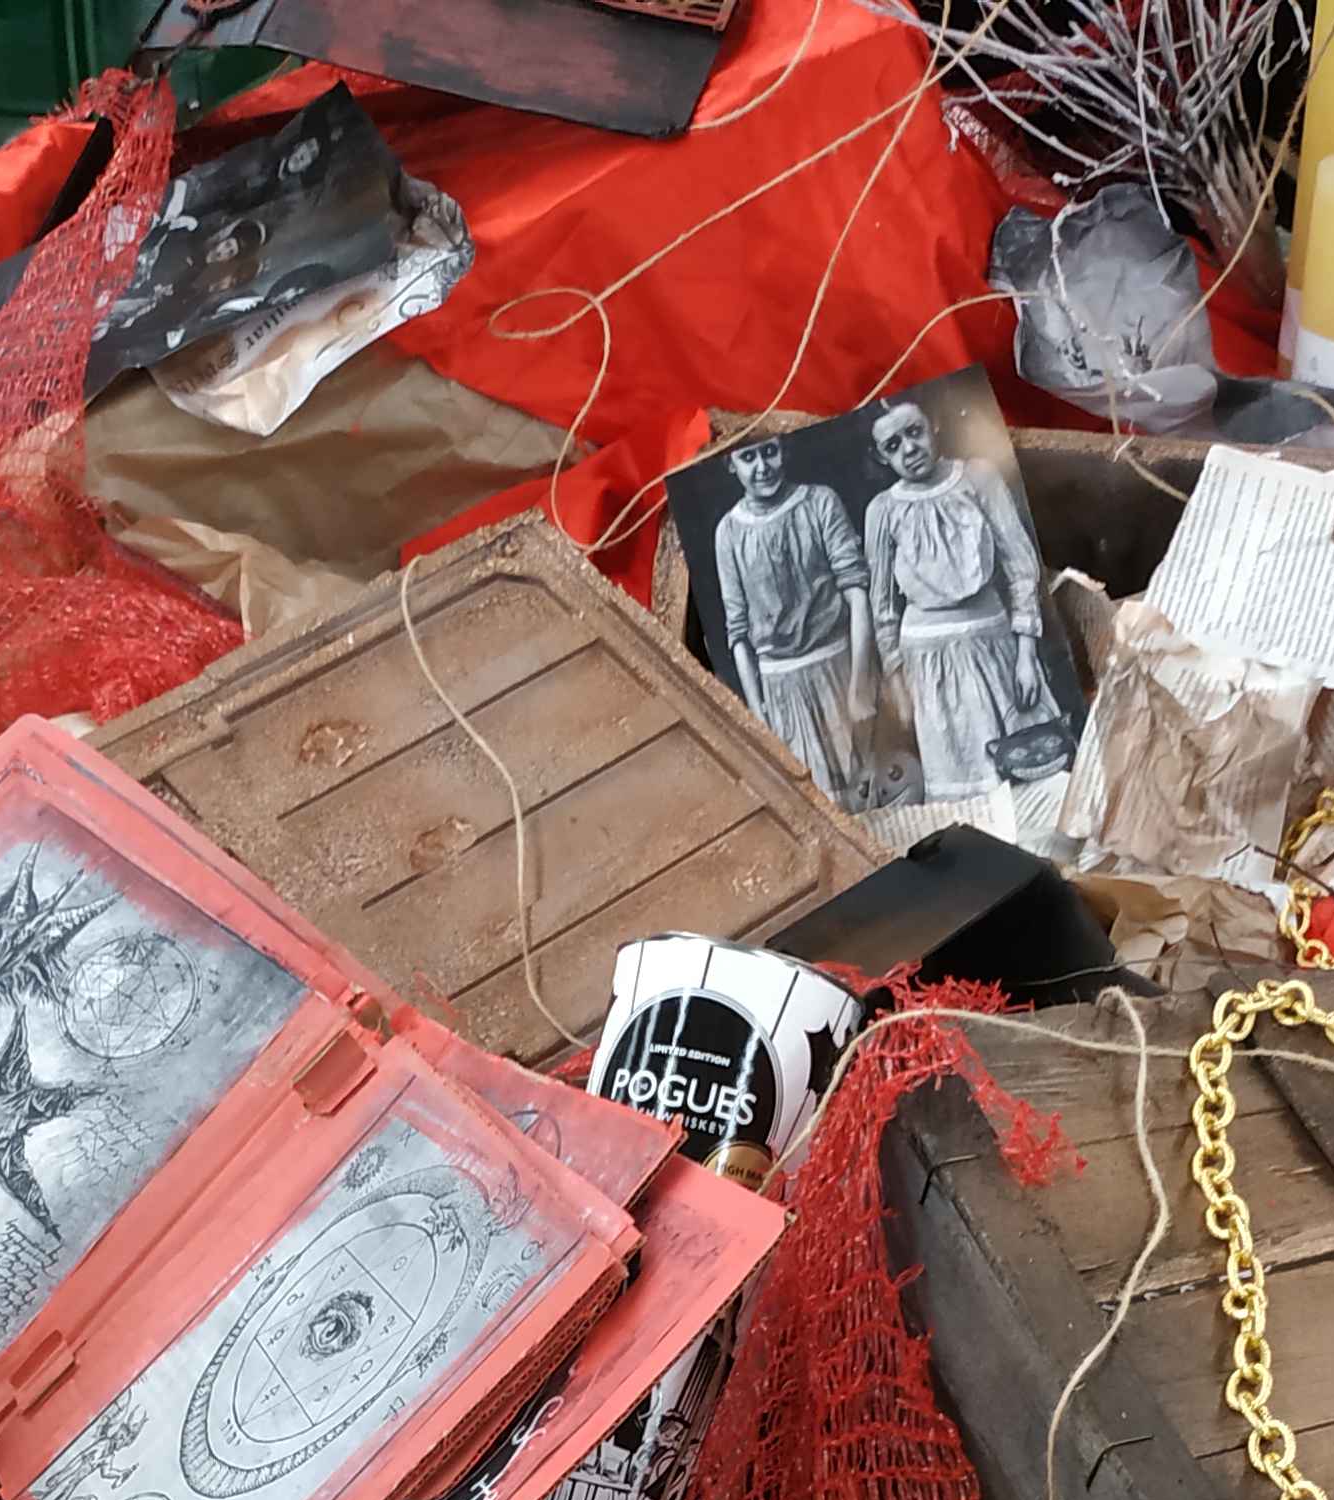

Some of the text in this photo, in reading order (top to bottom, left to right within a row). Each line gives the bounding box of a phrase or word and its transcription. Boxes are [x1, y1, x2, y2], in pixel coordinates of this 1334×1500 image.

[649, 1043, 731, 1067] LIMITED EDITION
[610, 1068, 757, 1126] POGUES
[659, 1111, 727, 1136] WISKEY
